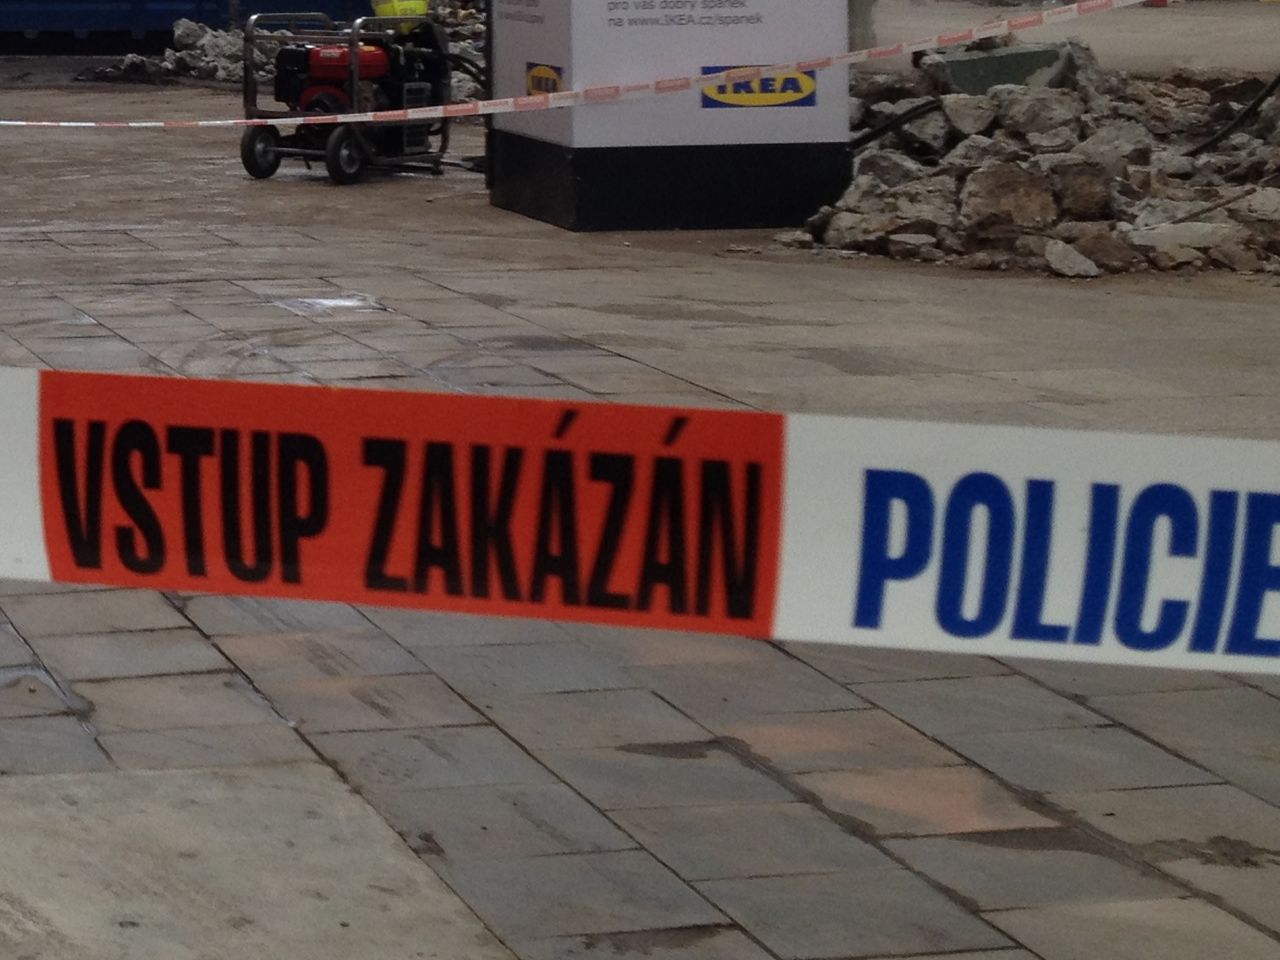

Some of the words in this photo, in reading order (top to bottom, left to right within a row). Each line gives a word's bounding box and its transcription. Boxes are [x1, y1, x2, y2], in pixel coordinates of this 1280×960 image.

[716, 76, 805, 95] IKEA
[51, 416, 332, 586] VSTUP
[360, 409, 764, 620] ZAKÁZÁN
[851, 467, 1280, 659] POLICIE
